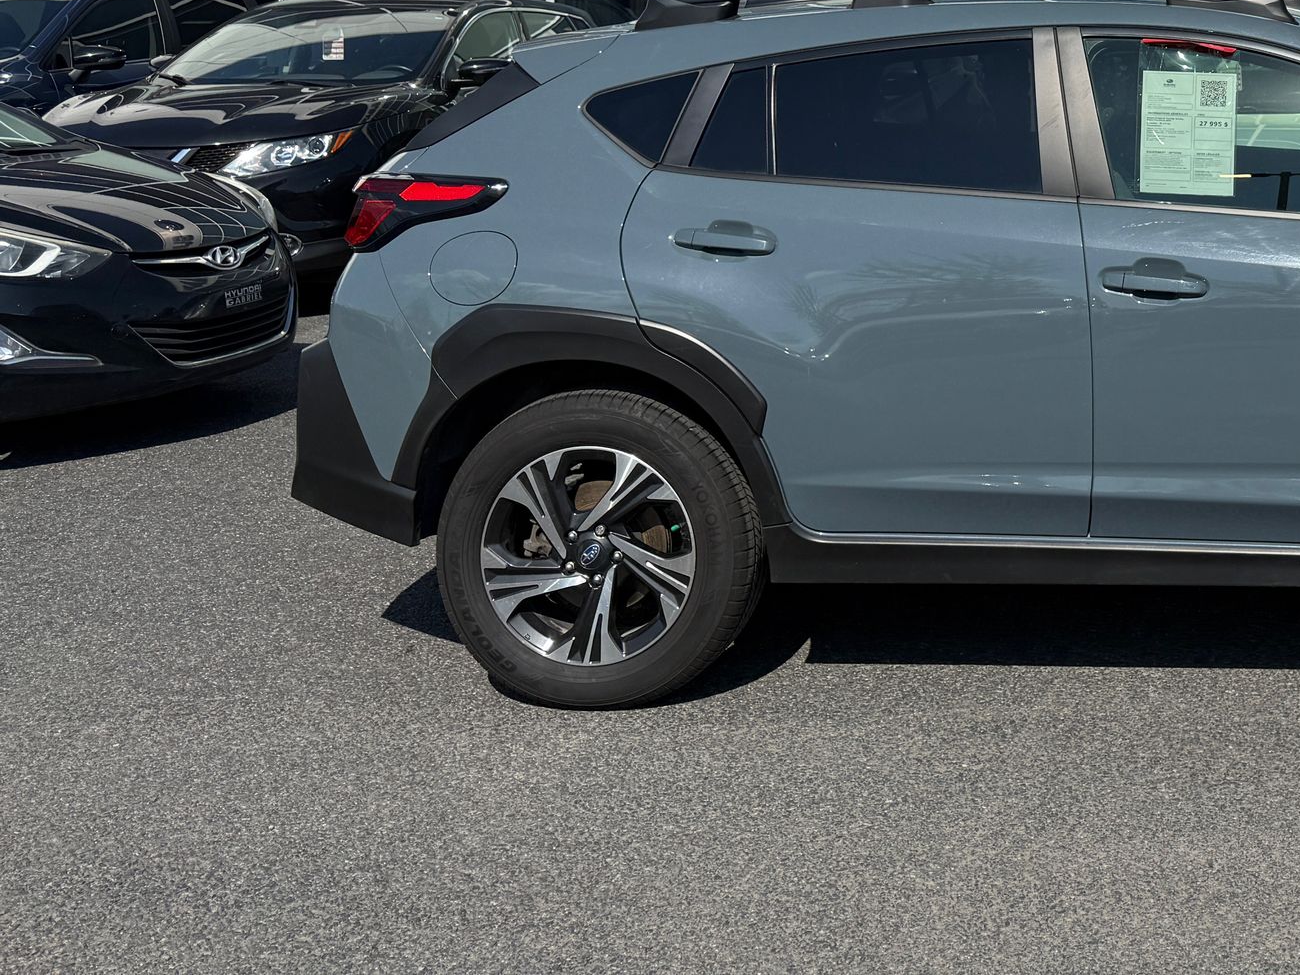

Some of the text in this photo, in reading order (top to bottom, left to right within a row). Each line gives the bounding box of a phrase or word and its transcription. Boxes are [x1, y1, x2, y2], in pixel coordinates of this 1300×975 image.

[224, 284, 262, 299] HYUNDAI
[226, 292, 262, 308] GABRIEL
[691, 483, 722, 573] YOKOHAM
[448, 540, 518, 674] GEOLANDA
